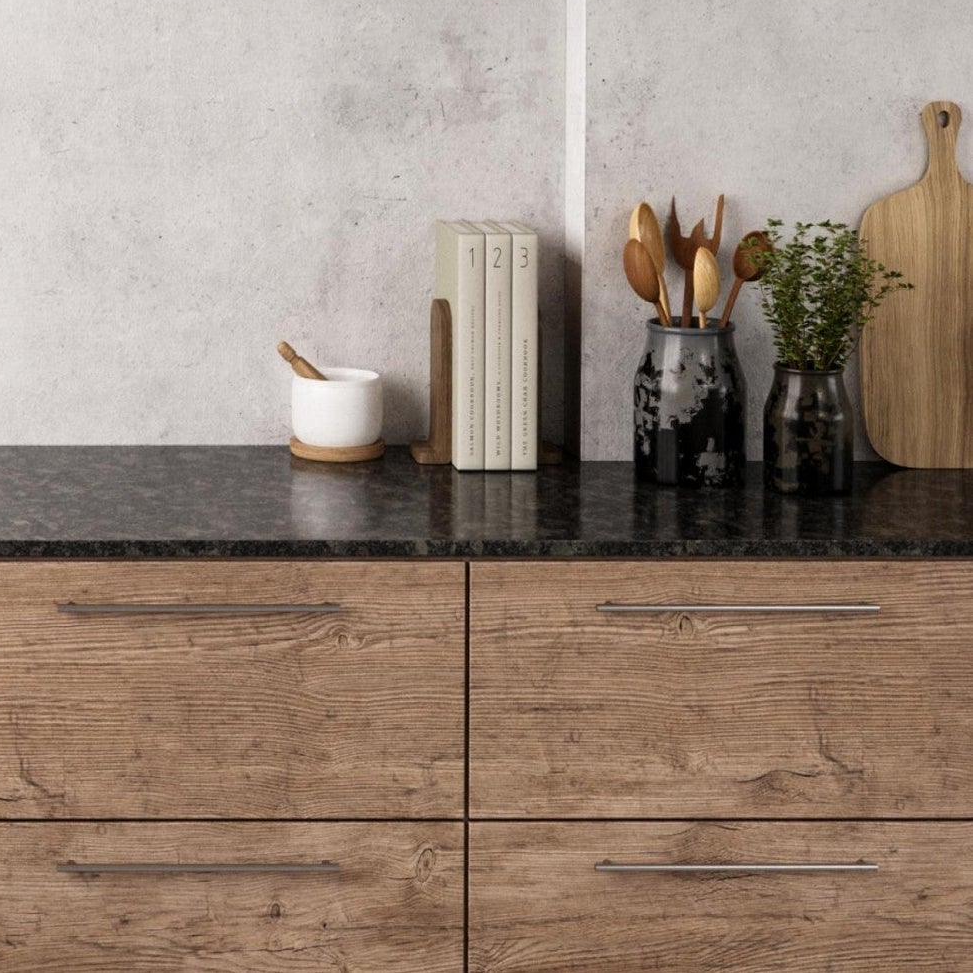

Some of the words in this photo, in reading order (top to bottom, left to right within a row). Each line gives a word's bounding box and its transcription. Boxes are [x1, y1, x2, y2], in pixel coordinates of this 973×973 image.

[469, 247, 474, 268] 1
[493, 247, 502, 268] 2
[520, 247, 529, 268] 3
